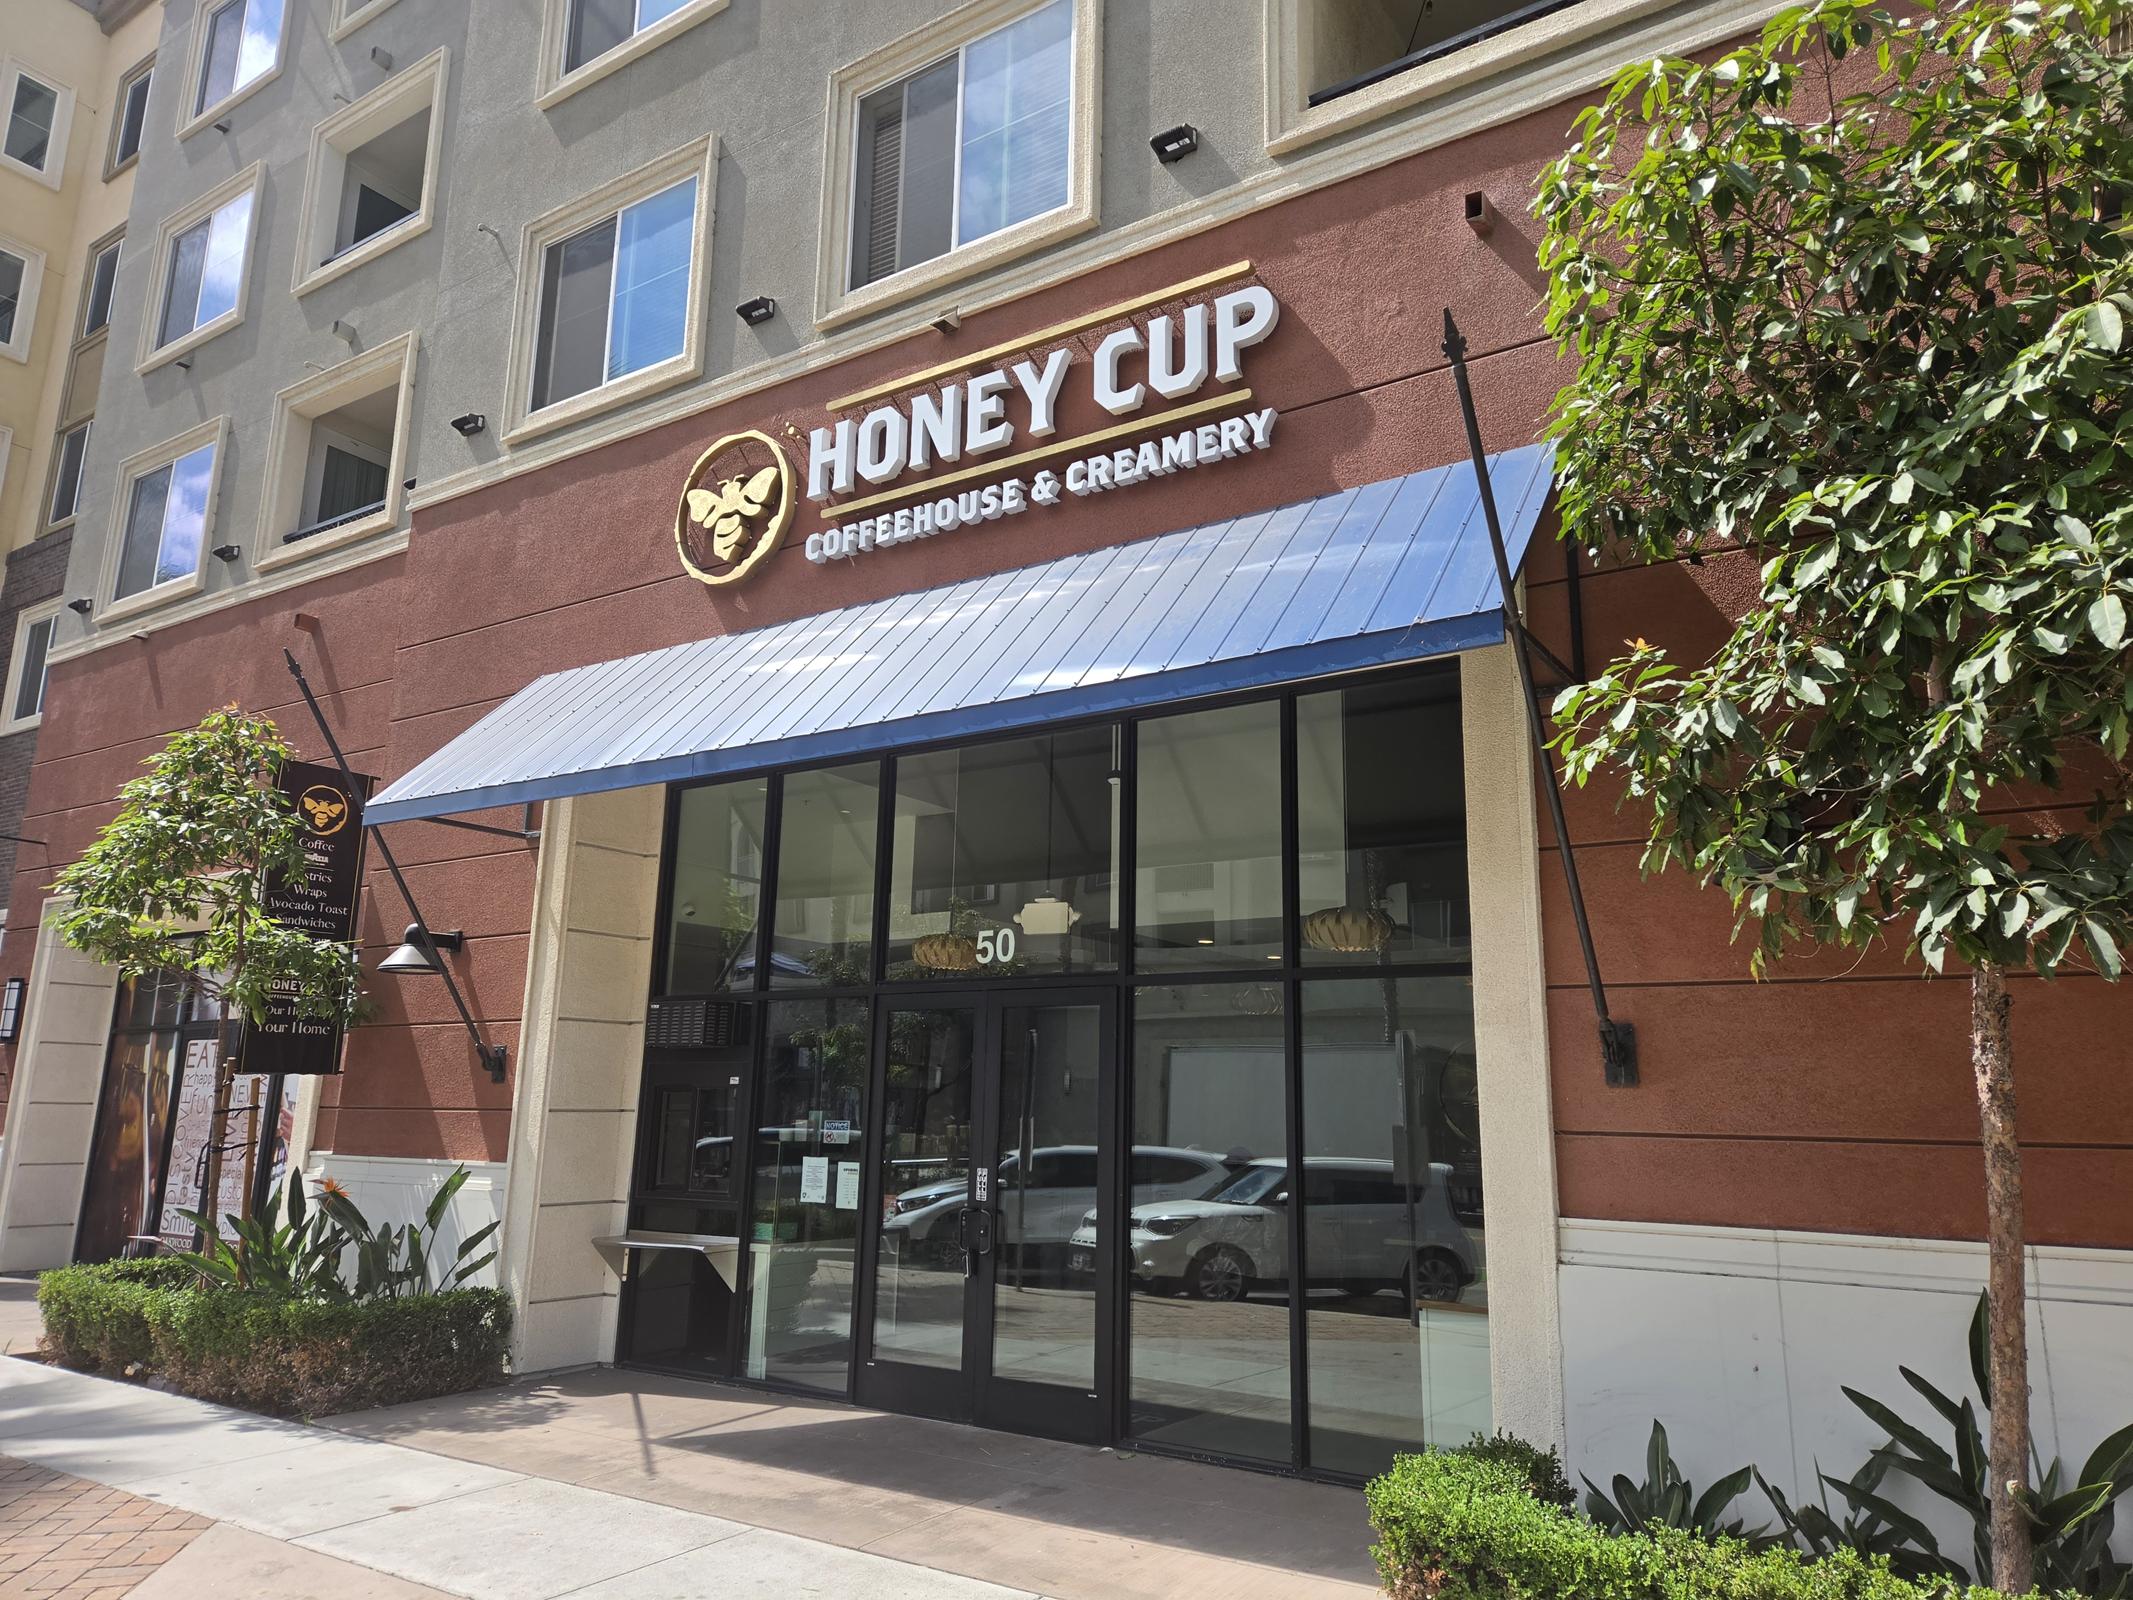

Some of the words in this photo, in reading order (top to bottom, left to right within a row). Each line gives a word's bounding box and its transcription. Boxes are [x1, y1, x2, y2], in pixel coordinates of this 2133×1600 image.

[806, 348, 1072, 501] HONEY
[1093, 286, 1279, 416] CUP
[804, 477, 1027, 565] COFFEEHOUSE
[1031, 469, 1060, 505] &
[1065, 407, 1278, 497] CREAMERY
[298, 837, 335, 852] Coffee
[303, 872, 332, 884] stries
[293, 883, 328, 899] Wraps
[268, 897, 315, 912] Avocado
[318, 901, 348, 916] Toast
[274, 912, 336, 930] Sandwiches
[975, 928, 1015, 964] 50
[268, 979, 304, 991] ONEY
[292, 1021, 331, 1036] Home
[825, 1122, 849, 1130] NOTICE
